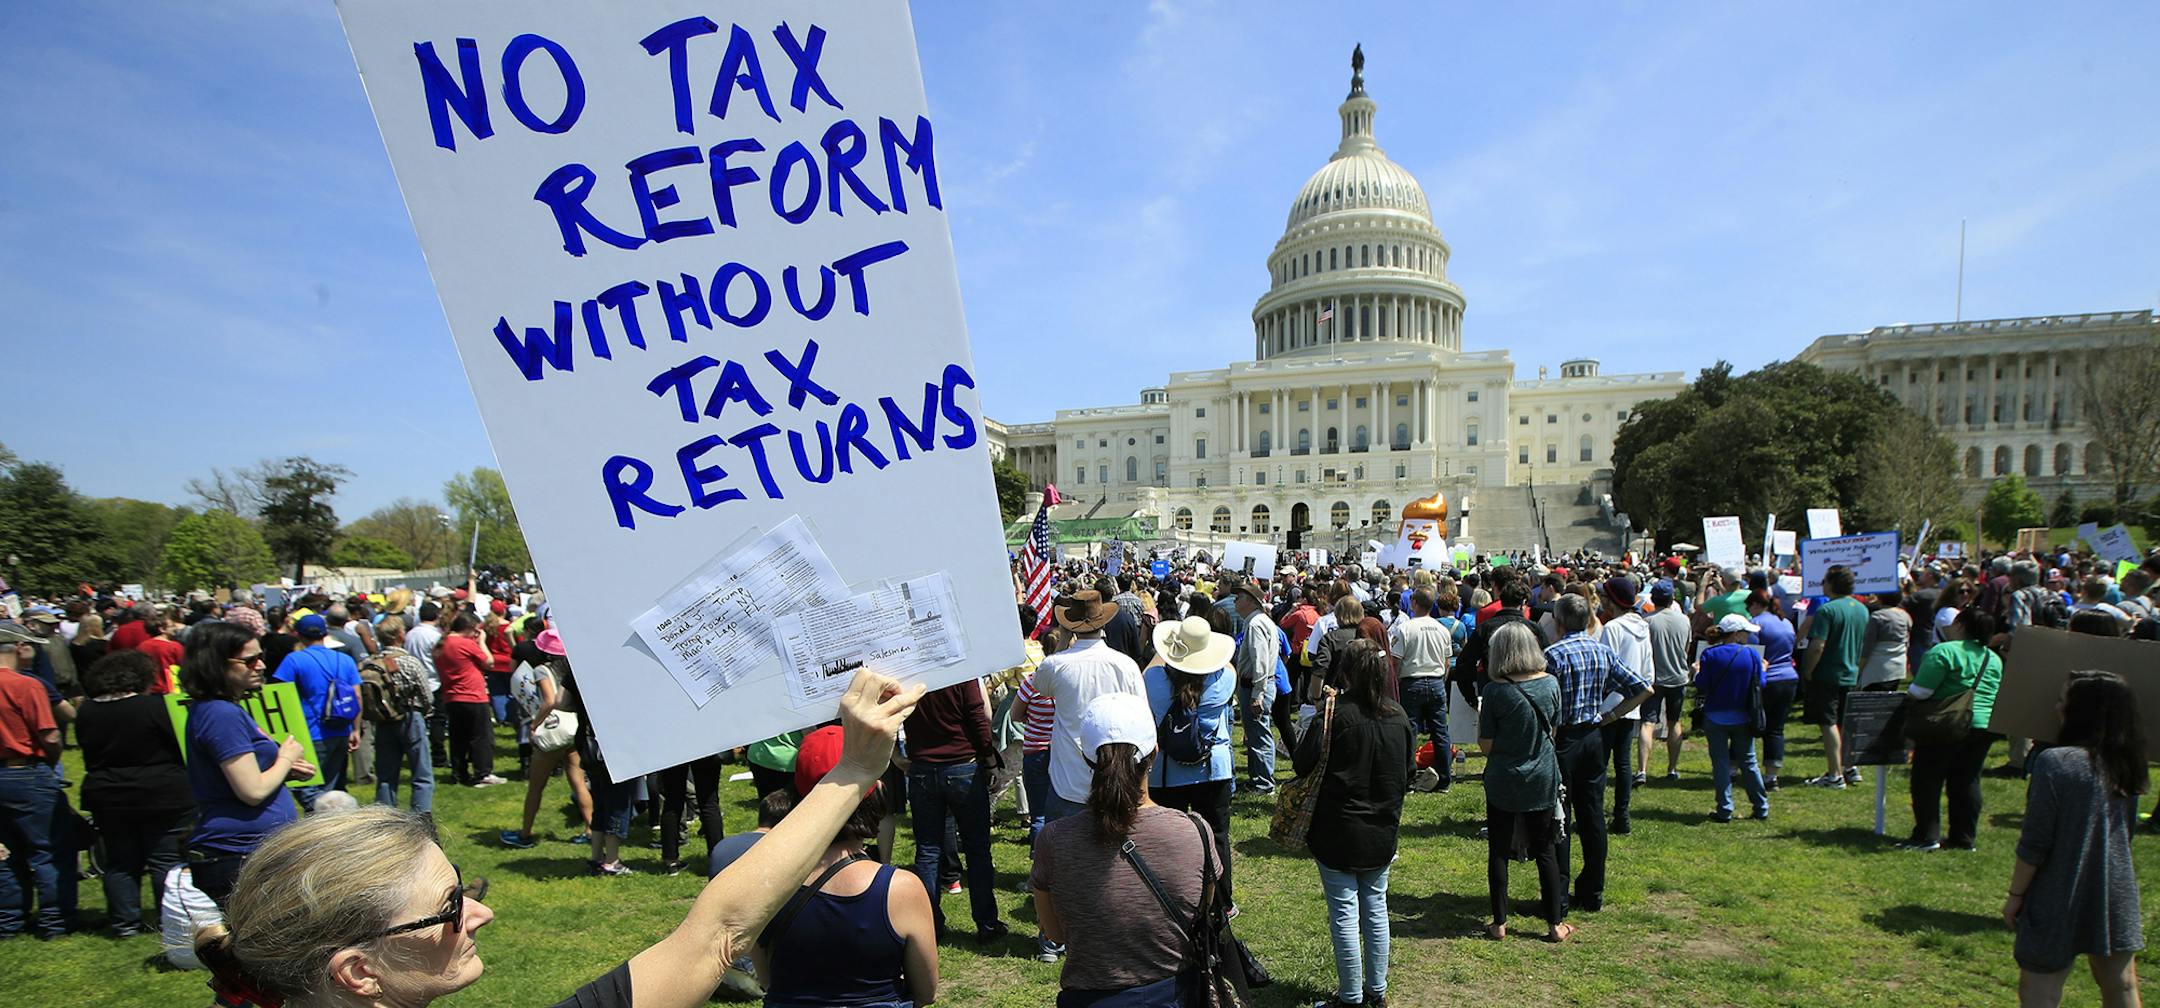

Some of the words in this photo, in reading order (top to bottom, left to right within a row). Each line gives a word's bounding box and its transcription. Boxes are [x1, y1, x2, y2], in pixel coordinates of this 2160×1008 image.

[414, 34, 585, 151] NO
[640, 16, 843, 134] TAX
[535, 115, 942, 256] REFORM
[493, 241, 909, 380] WITHOUT
[648, 340, 838, 423] TAX
[603, 364, 976, 529] RETURNS
[657, 619, 673, 631] 1040
[660, 621, 693, 643] Donald
[712, 587, 744, 606] Trump
[672, 634, 703, 652] Trump
[699, 611, 729, 632] Tower
[870, 645, 911, 661] Salesman
